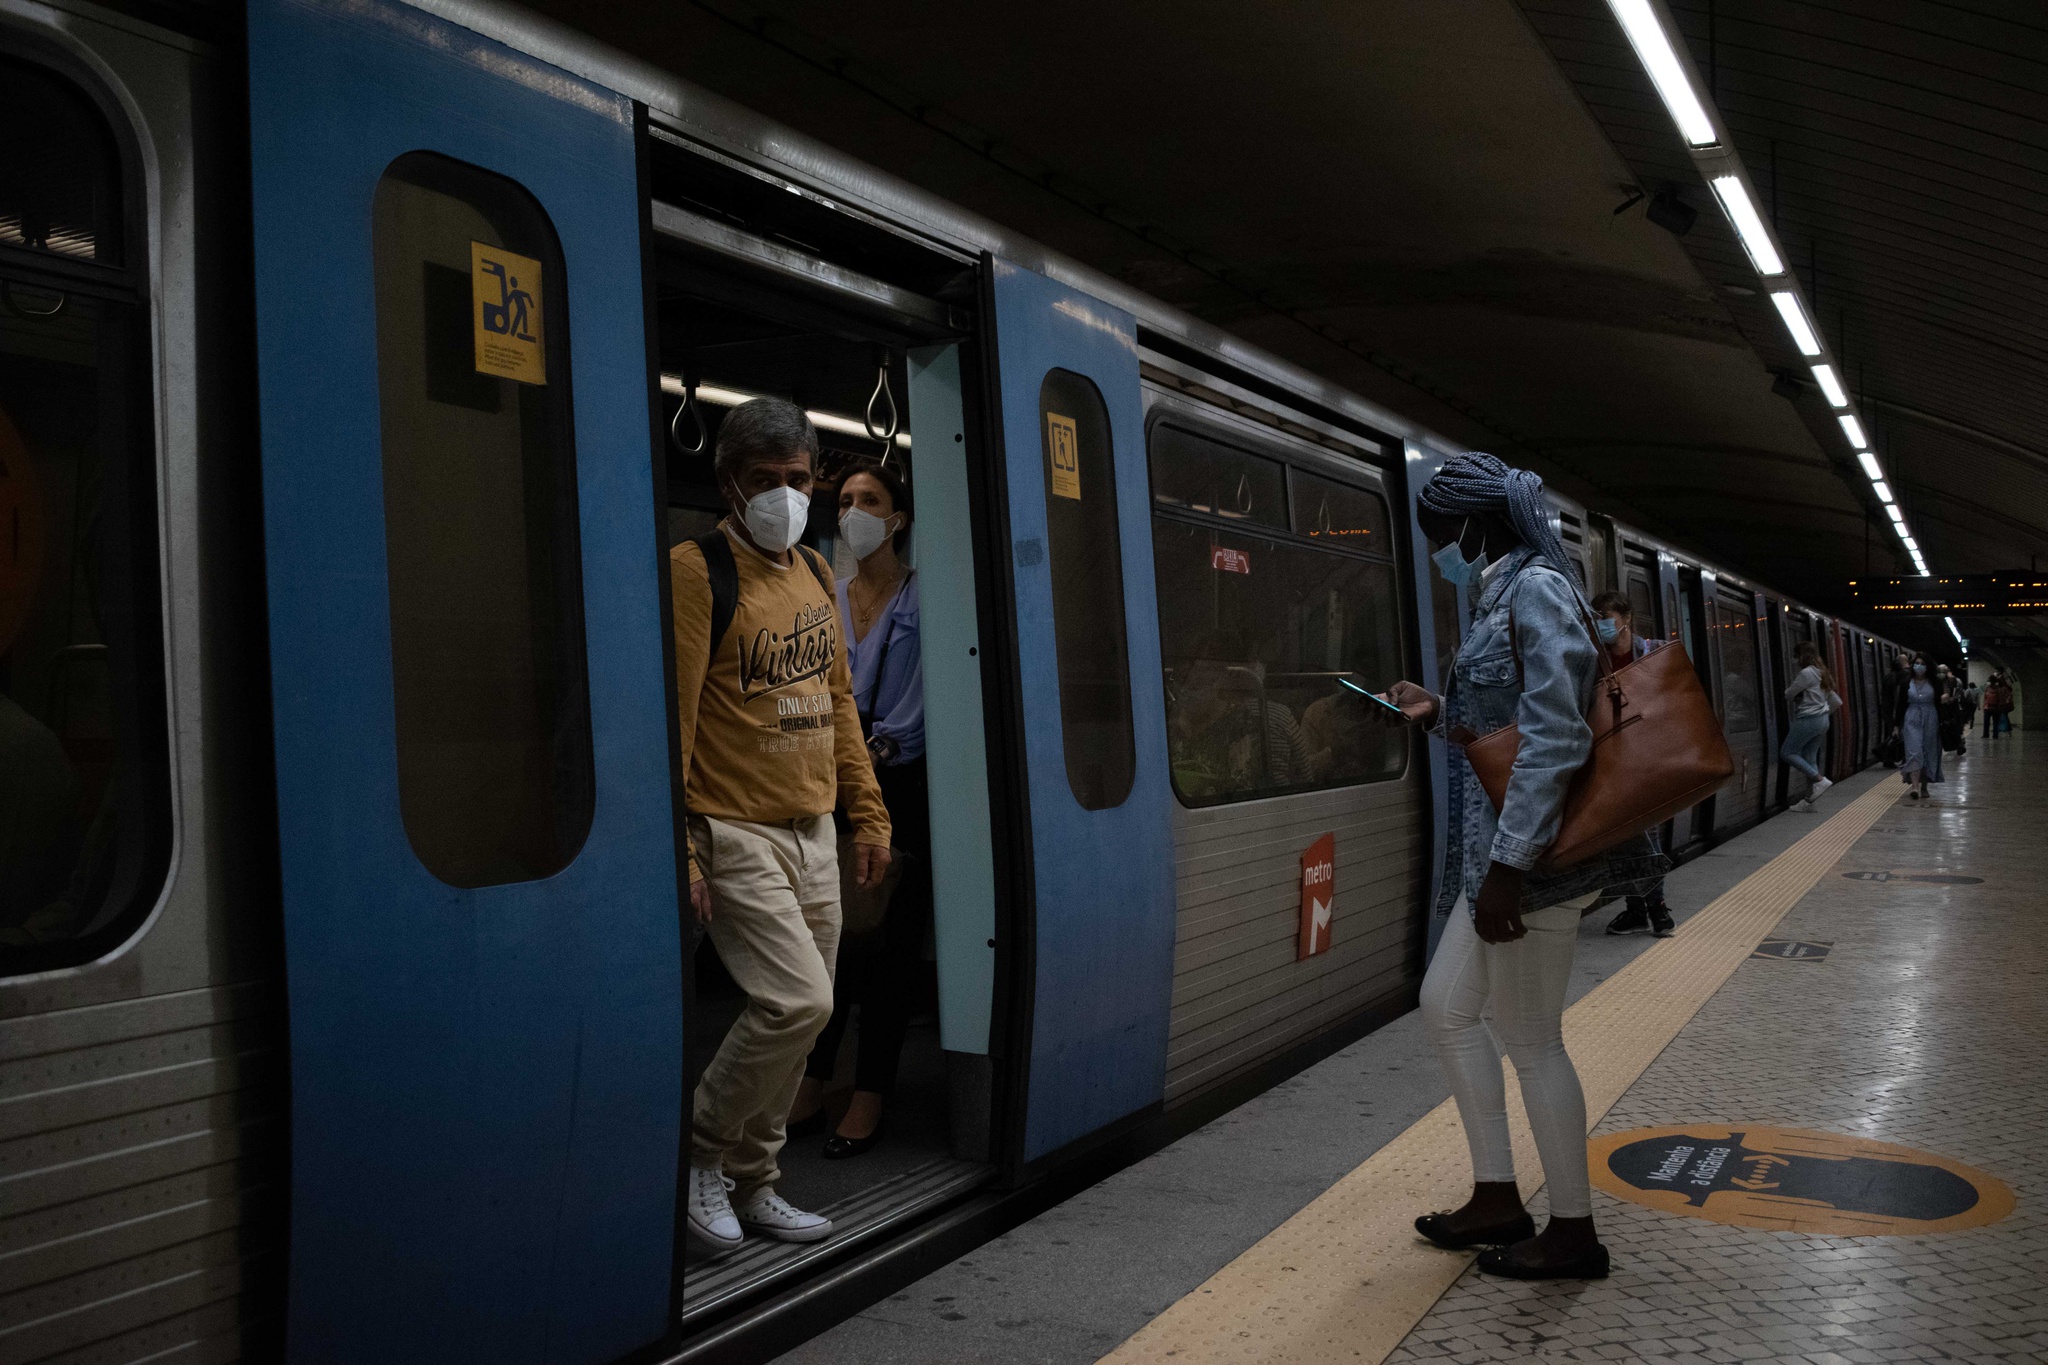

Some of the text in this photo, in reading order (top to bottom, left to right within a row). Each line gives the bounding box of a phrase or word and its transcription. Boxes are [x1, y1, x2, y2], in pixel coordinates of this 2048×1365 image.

[803, 601, 831, 626] Denim
[738, 611, 836, 689] Vintage
[777, 696, 809, 716] ONLY
[780, 715, 819, 732] ORIGINAL
[757, 733, 800, 753] TRUE
[1305, 861, 1332, 886] metro
[1647, 1145, 1695, 1181] Mantenha
[1687, 1147, 1731, 1186] a distância
